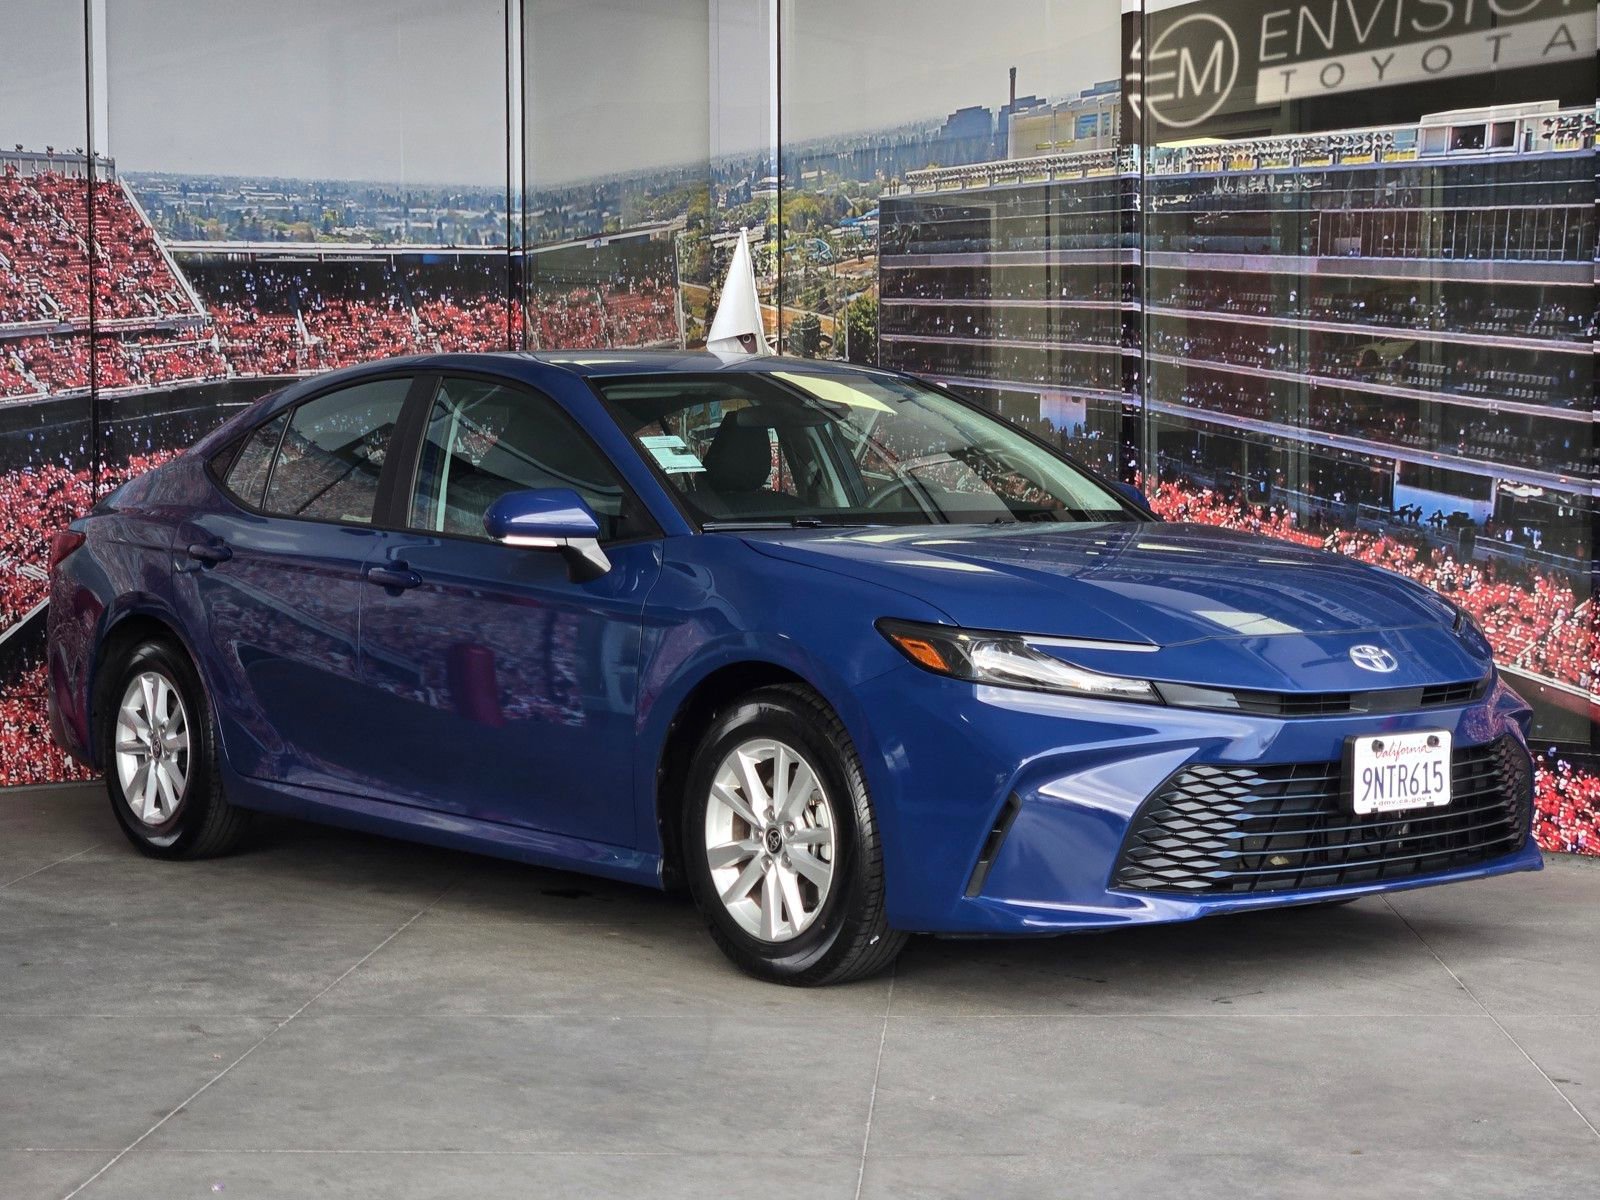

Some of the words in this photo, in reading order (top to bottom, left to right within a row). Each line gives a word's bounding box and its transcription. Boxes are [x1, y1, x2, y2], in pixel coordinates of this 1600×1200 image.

[1259, 0, 1571, 61] ENVIS
[1280, 23, 1577, 94] TOYOTA
[1361, 760, 1443, 802] 9NTR615
[1378, 796, 1427, 807] dmv.ca.gov
